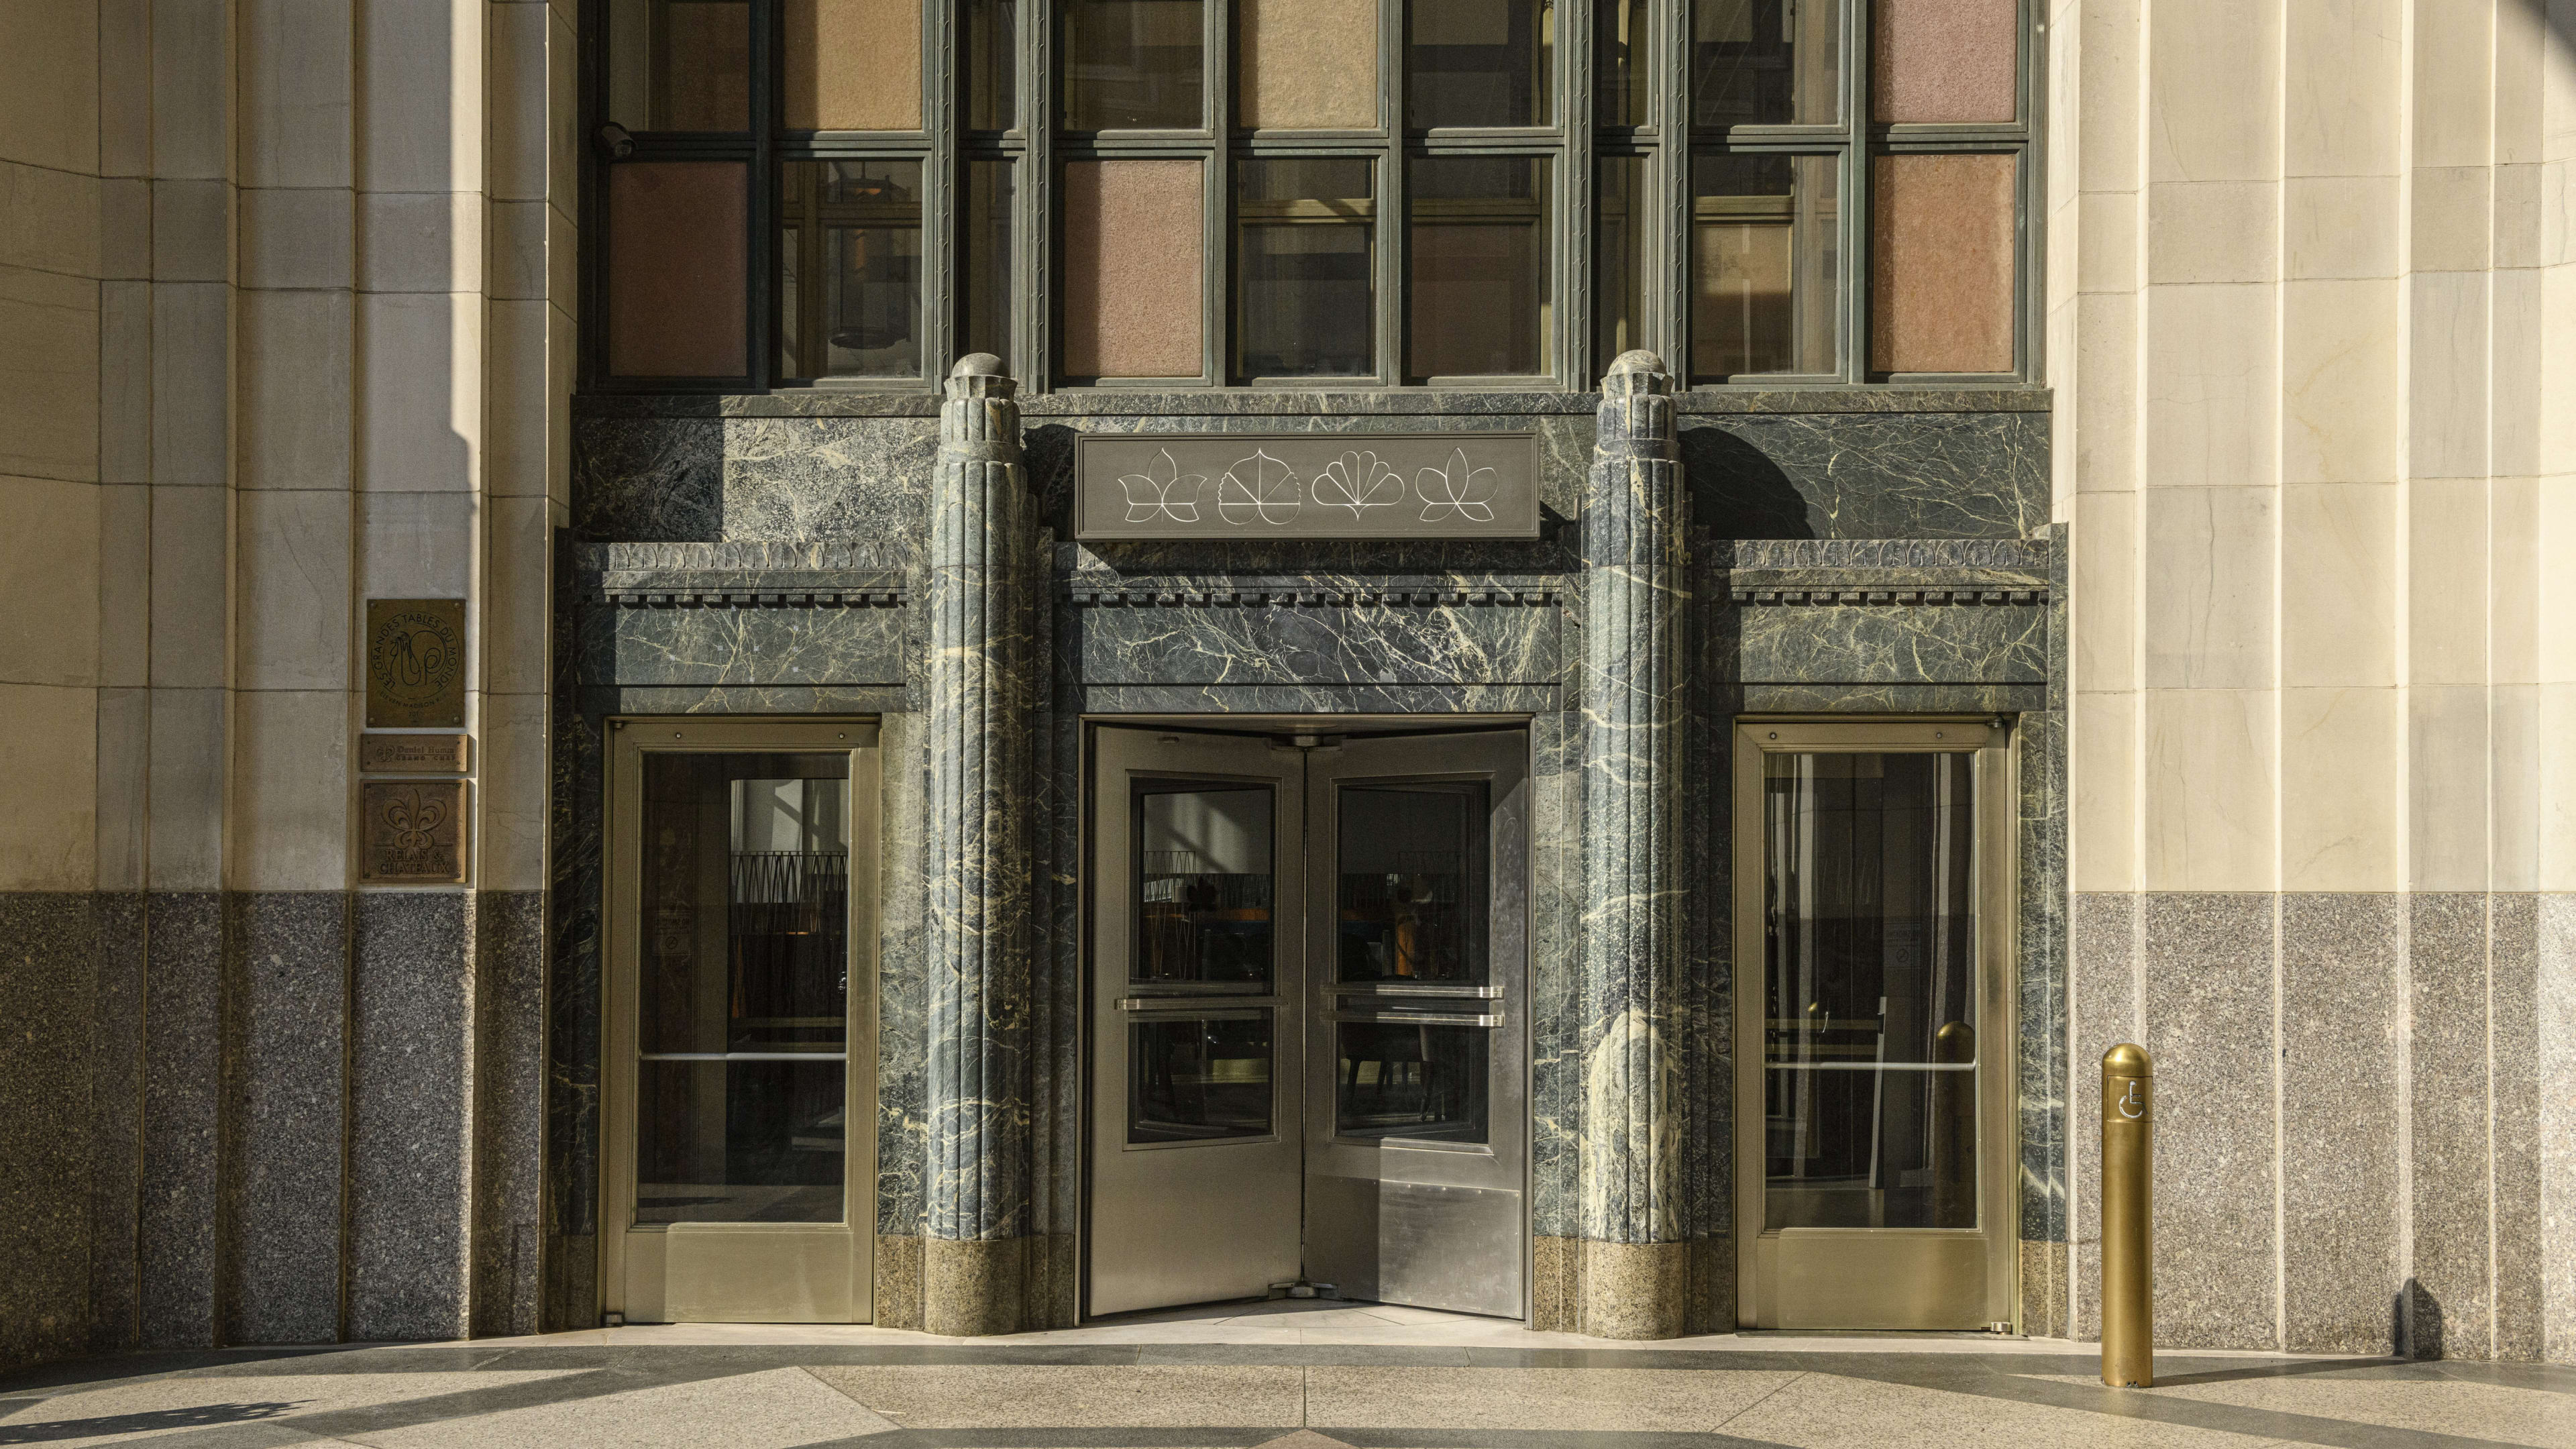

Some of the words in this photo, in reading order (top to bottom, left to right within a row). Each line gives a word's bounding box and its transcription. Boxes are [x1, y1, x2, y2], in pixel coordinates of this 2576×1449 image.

[402, 613, 440, 629] TABLES
[440, 627, 454, 643] DU
[373, 619, 400, 670] GRANDES
[434, 647, 457, 689] MONDE
[379, 673, 396, 690] LES
[402, 700, 435, 708] MADISON
[396, 745, 424, 753] Daniel
[428, 746, 454, 754] Humm
[385, 849, 428, 861] RELAIS
[433, 851, 443, 861] &
